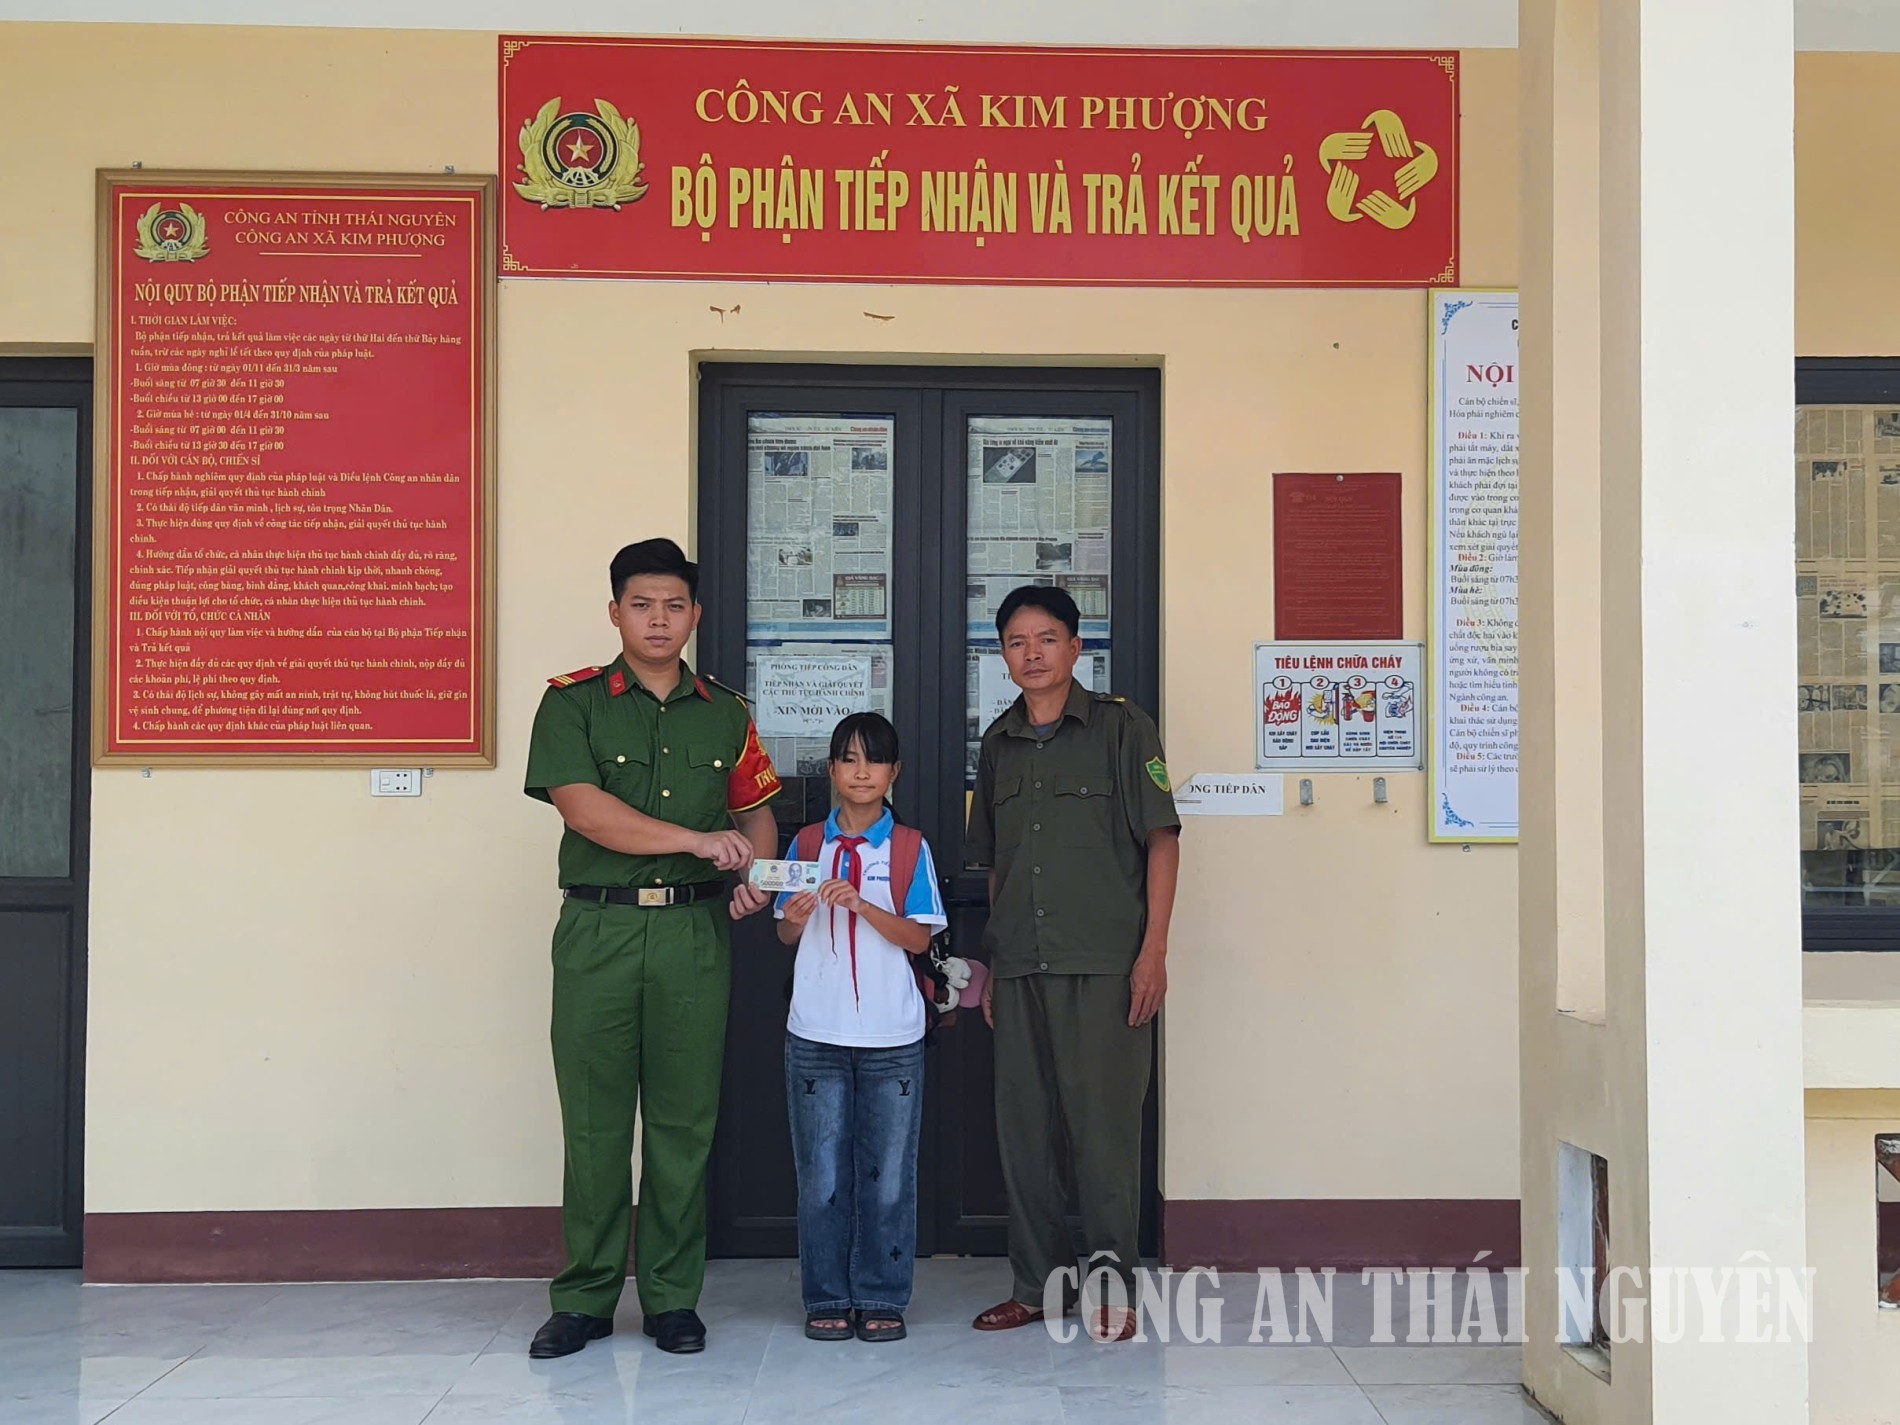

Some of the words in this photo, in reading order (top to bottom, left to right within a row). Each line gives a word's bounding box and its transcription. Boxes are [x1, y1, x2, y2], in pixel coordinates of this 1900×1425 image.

[696, 79, 823, 125] CÔNG
[833, 93, 893, 126] AN
[906, 86, 967, 127] XÃ
[980, 95, 1067, 129] KIM
[1081, 92, 1268, 138] PHƯỢNG
[672, 153, 716, 242] BỘ
[730, 155, 823, 244] PHẬN
[835, 149, 909, 231] TIẾP
[922, 158, 1016, 247] NHẬN
[1028, 160, 1072, 234] VÀ
[1083, 153, 1147, 235] TRẢ
[1159, 154, 1220, 236] KẾT
[1232, 154, 1299, 243] QUẢ
[224, 209, 270, 223] CÔNG
[274, 212, 297, 224] AN
[304, 210, 340, 224] TỈNH
[347, 210, 382, 225] THÁI
[388, 211, 455, 226] NGUYÊN
[235, 228, 281, 243] CÔNG
[285, 232, 308, 244] AN
[313, 229, 335, 244] XÃ
[341, 232, 371, 244] KIM
[377, 232, 444, 248] PHƯỢNG
[135, 277, 160, 306] NỘI
[164, 283, 192, 305] QUY
[197, 278, 216, 306] BỘ
[220, 278, 259, 306] PHẬN
[262, 278, 296, 302] TIẾP
[299, 279, 339, 307] NHẬN
[343, 279, 361, 303] VÀ
[365, 279, 392, 303] TRẢ
[397, 279, 424, 304] KẾT
[428, 279, 457, 308] QUẢ
[1466, 361, 1514, 388] NỘI
[1274, 655, 1300, 669] TIÊU
[1303, 654, 1333, 672] LỆNH
[1337, 654, 1369, 669] CHỮA
[1372, 654, 1402, 669] CHÁY
[1279, 679, 1285, 687] 1
[1316, 678, 1324, 687] 2
[1354, 678, 1361, 687] 3
[1391, 678, 1398, 687] 4
[777, 706, 797, 716] XIN
[800, 704, 823, 716] MỜI
[825, 704, 850, 716] VÀO
[1214, 782, 1240, 794] TIẾP
[1242, 783, 1266, 794] DÂN
